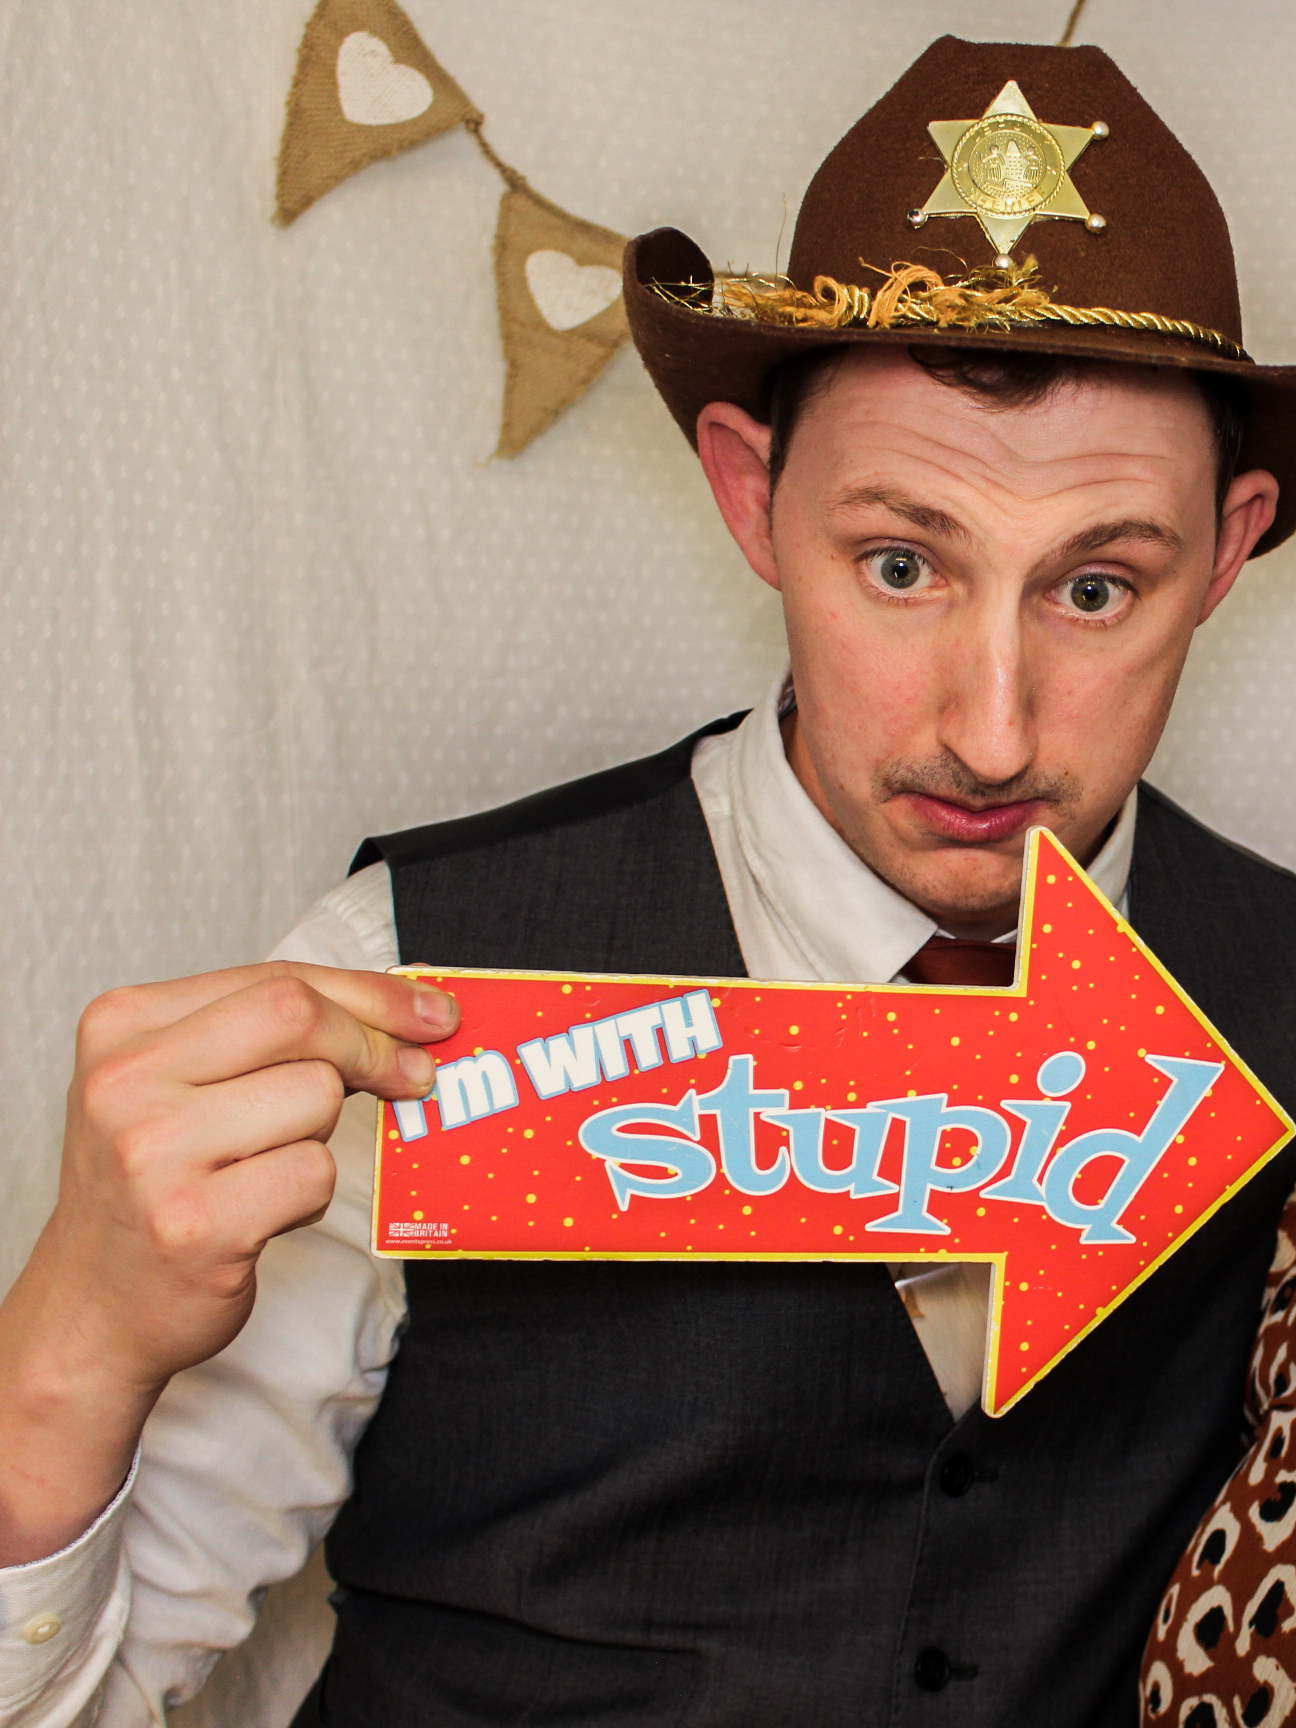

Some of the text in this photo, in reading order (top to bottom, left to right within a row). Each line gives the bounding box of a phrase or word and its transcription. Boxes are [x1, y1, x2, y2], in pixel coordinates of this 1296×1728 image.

[393, 988, 724, 1142] Im WITH
[578, 1051, 1225, 1244] stupid
